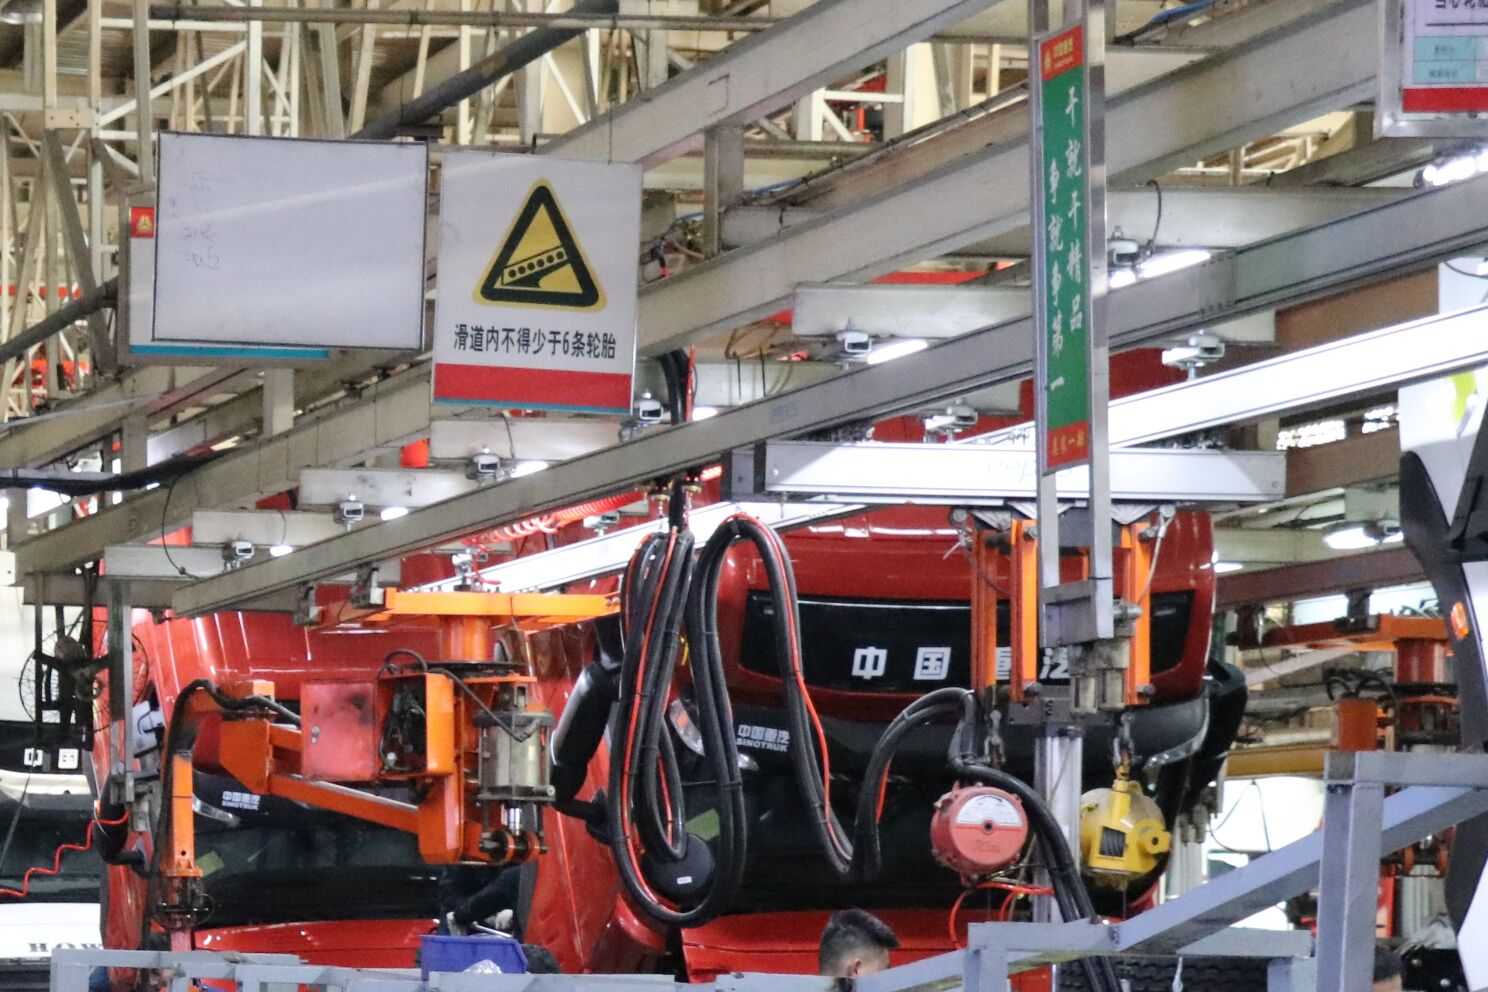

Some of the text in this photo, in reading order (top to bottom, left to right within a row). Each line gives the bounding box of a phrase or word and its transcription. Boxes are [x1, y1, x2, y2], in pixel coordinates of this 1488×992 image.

[453, 323, 617, 359] 滑道内不得少于6条轮胎
